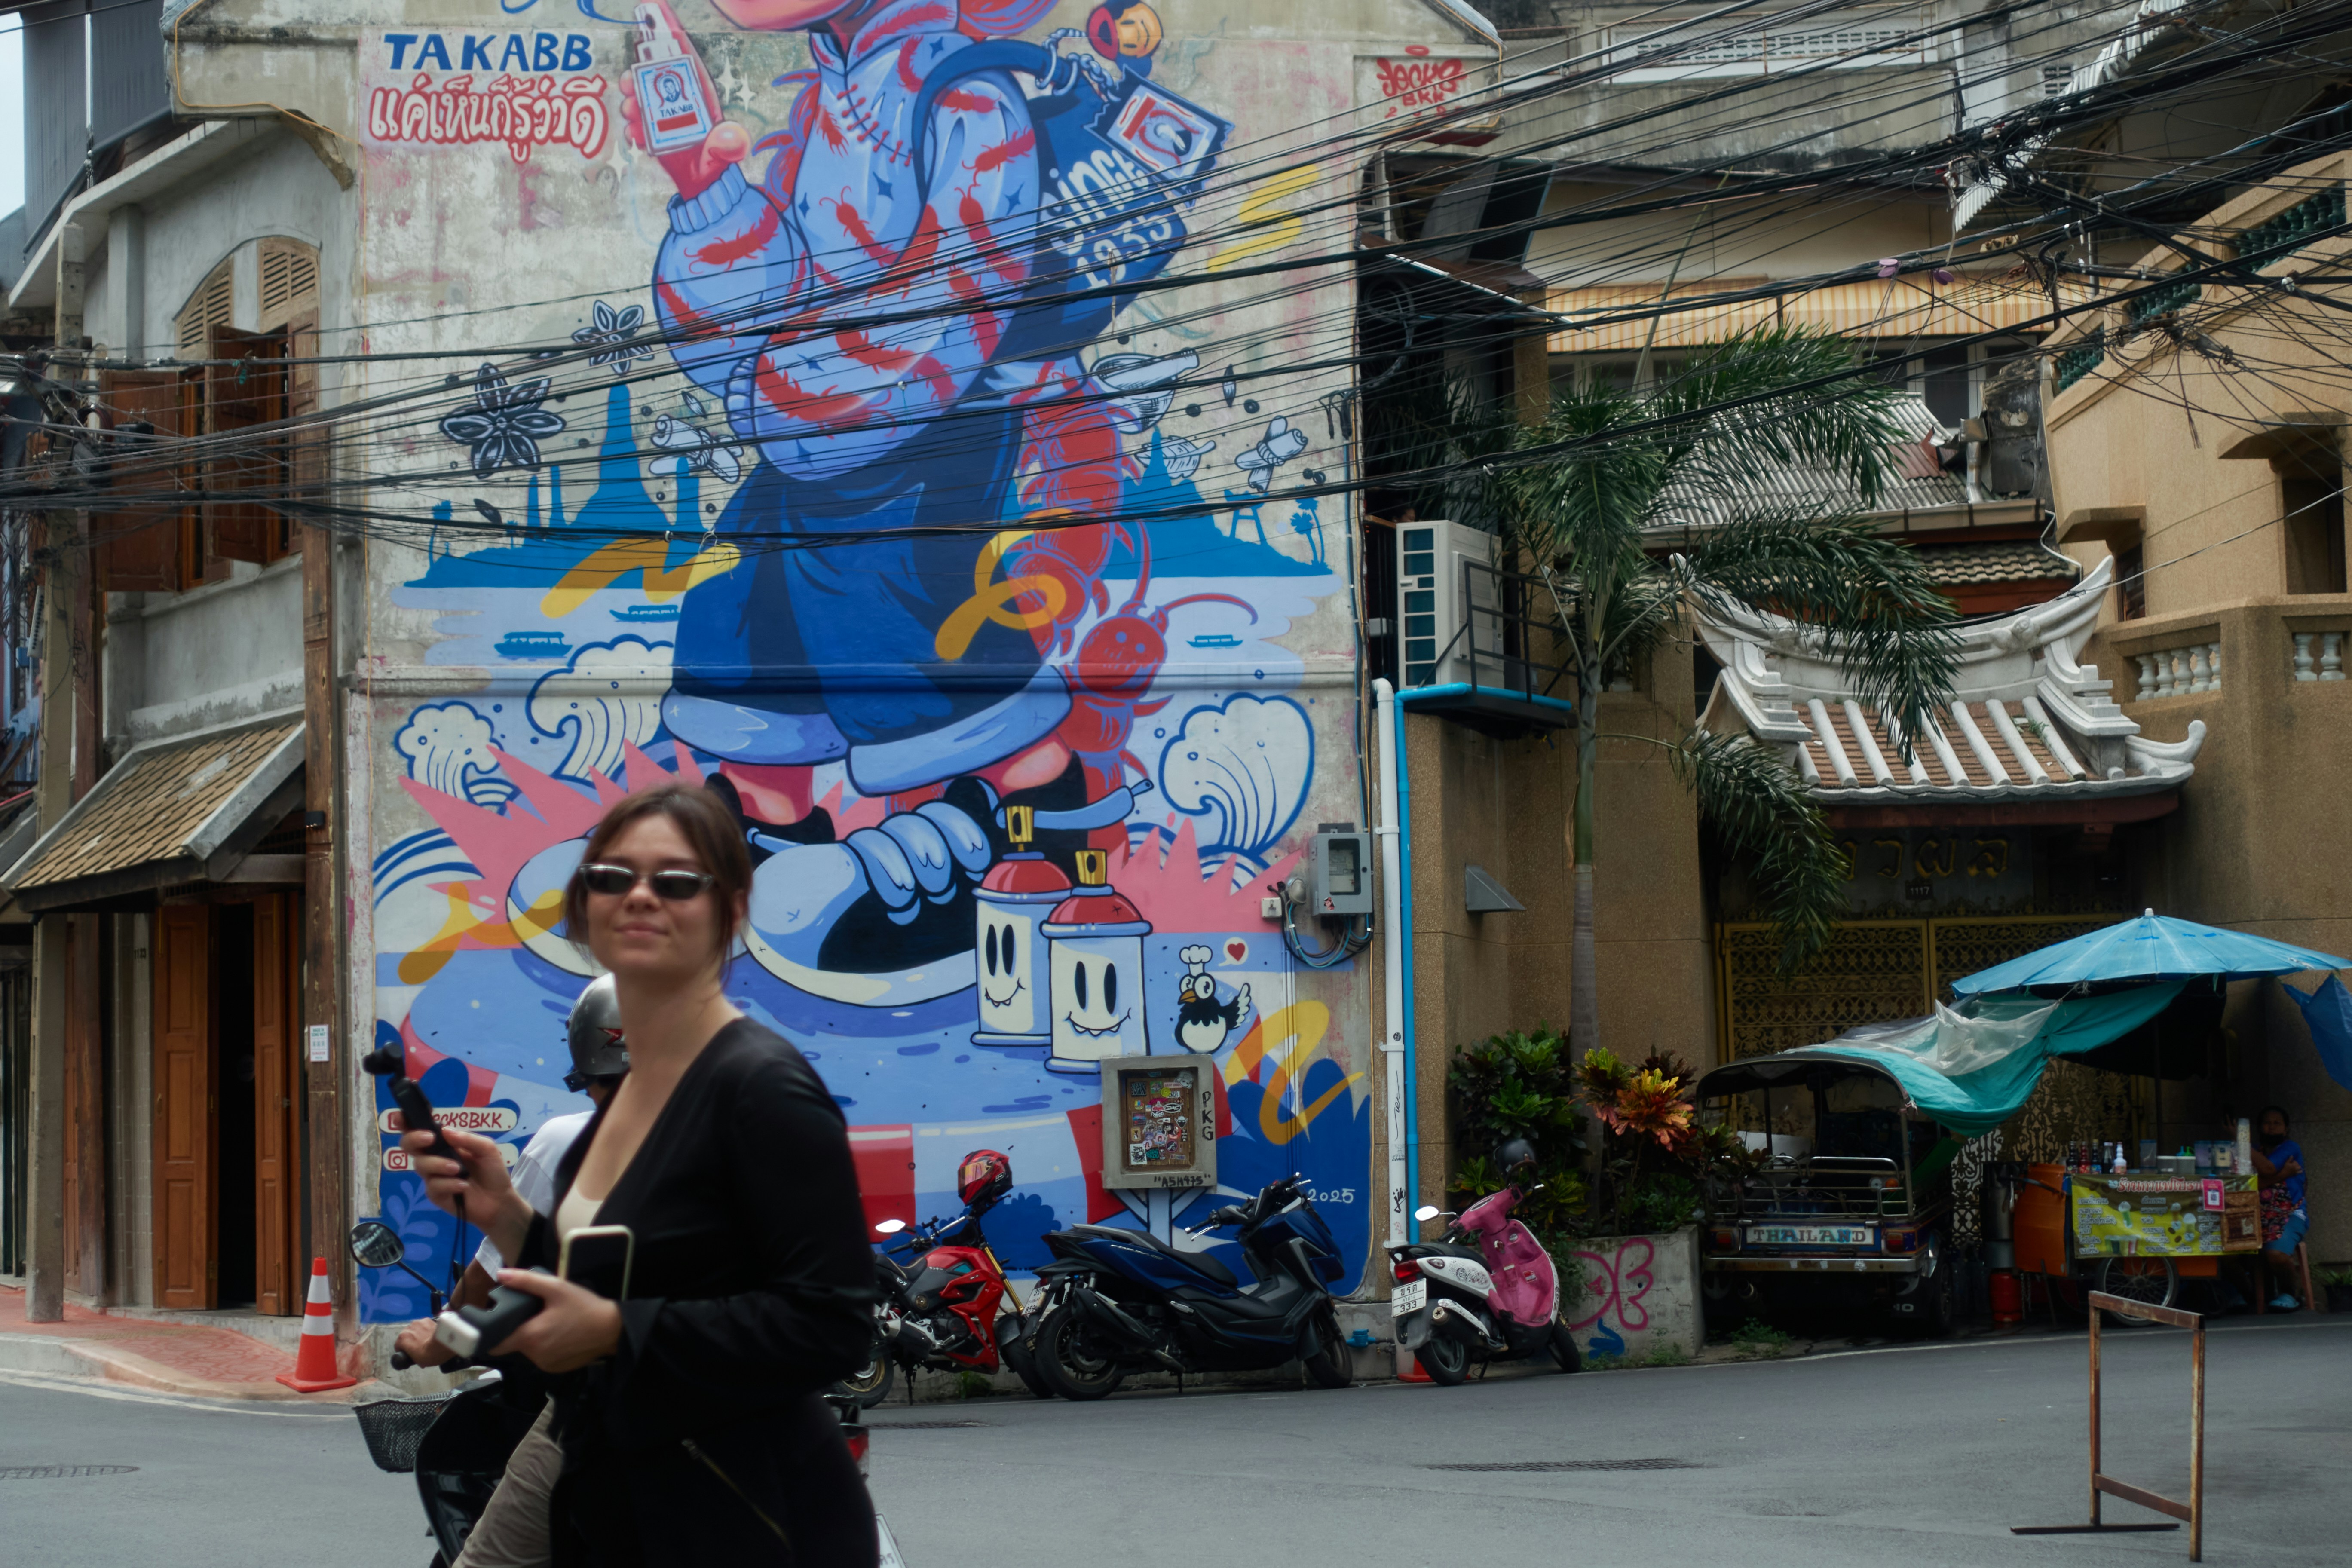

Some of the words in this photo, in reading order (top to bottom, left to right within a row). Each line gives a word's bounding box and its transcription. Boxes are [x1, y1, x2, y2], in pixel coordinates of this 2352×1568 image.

[384, 34, 593, 72] TAKABB
[1403, 88, 1445, 106] BKK
[369, 72, 609, 164] แค่เห็นก็รู้ว่าดี
[660, 104, 693, 118] TAKABB
[1910, 885, 1930, 895] 1117
[2117, 1176, 2202, 1193] ร้านกาแฟโบรา
[1308, 1188, 1355, 1204] 2025
[1753, 1229, 1866, 1242] THAILAND
[1400, 1301, 1417, 1312] 333
